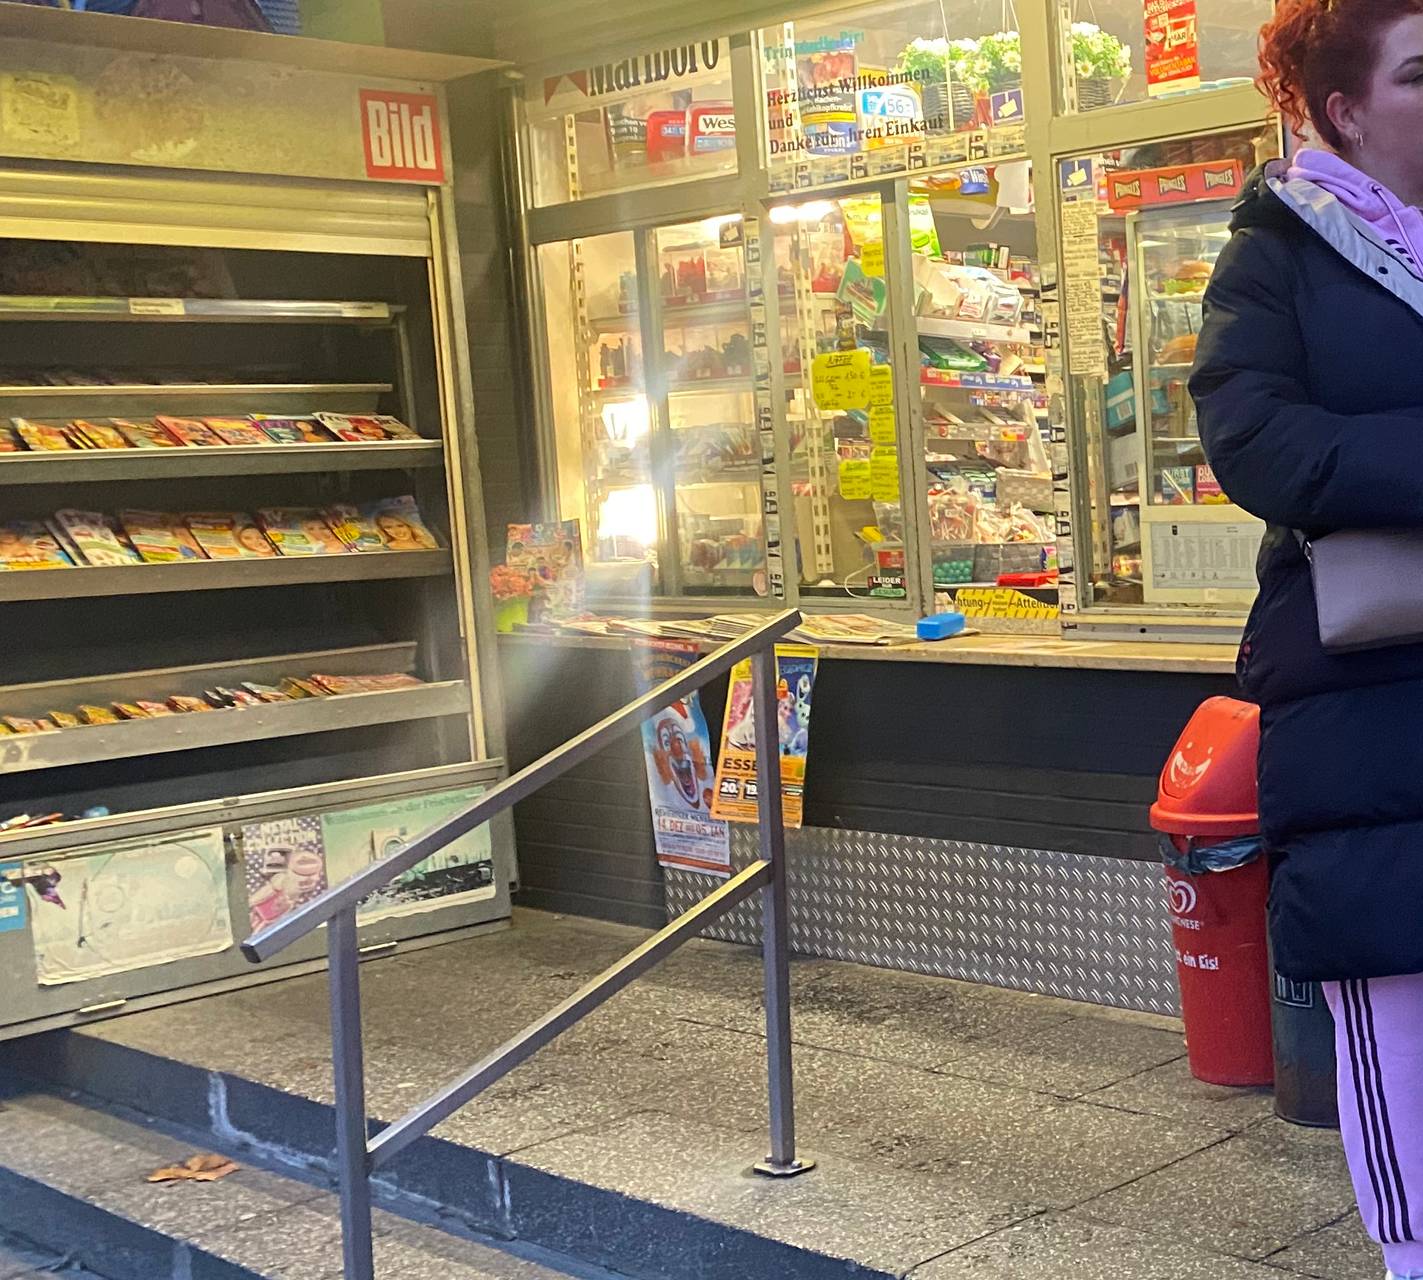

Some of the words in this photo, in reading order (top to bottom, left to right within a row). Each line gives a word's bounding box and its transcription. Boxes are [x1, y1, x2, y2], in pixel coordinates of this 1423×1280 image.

[589, 39, 719, 96] Marlboro
[766, 84, 835, 108] Herzlichst
[838, 67, 931, 93] Willkommen
[887, 98, 904, 114] 56
[703, 115, 736, 130] Wes
[768, 113, 794, 130] und
[366, 99, 438, 170] Bild
[770, 133, 813, 155] Danke
[814, 128, 837, 148] für
[848, 124, 883, 143] Ihren
[885, 113, 945, 138] Einkauf
[872, 576, 902, 585] LEIDER
[950, 597, 984, 610] chtung
[722, 757, 758, 772] ESSE
[1198, 953, 1219, 970] Eis!
